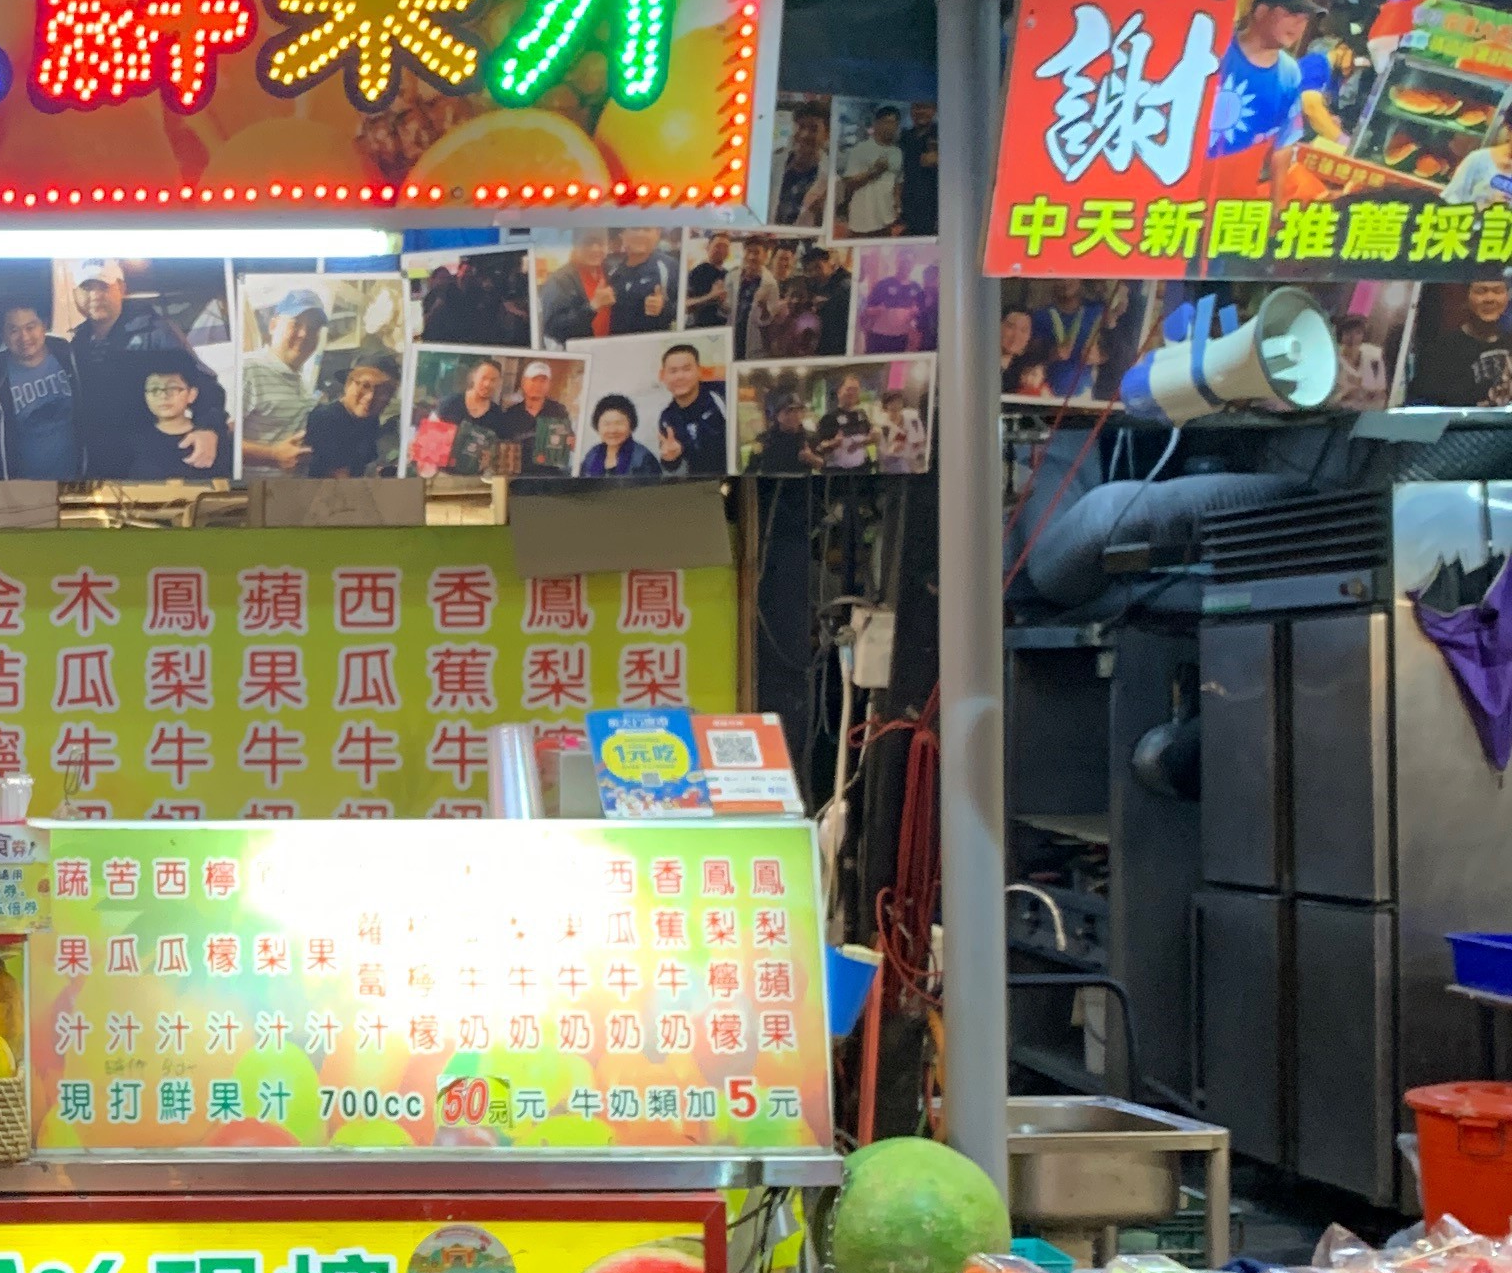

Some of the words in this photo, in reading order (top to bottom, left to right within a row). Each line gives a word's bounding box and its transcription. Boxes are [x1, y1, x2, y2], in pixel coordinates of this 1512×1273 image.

[60, 1081, 292, 1122] 現打鮮果汁
[320, 1088, 423, 1118] 700cc
